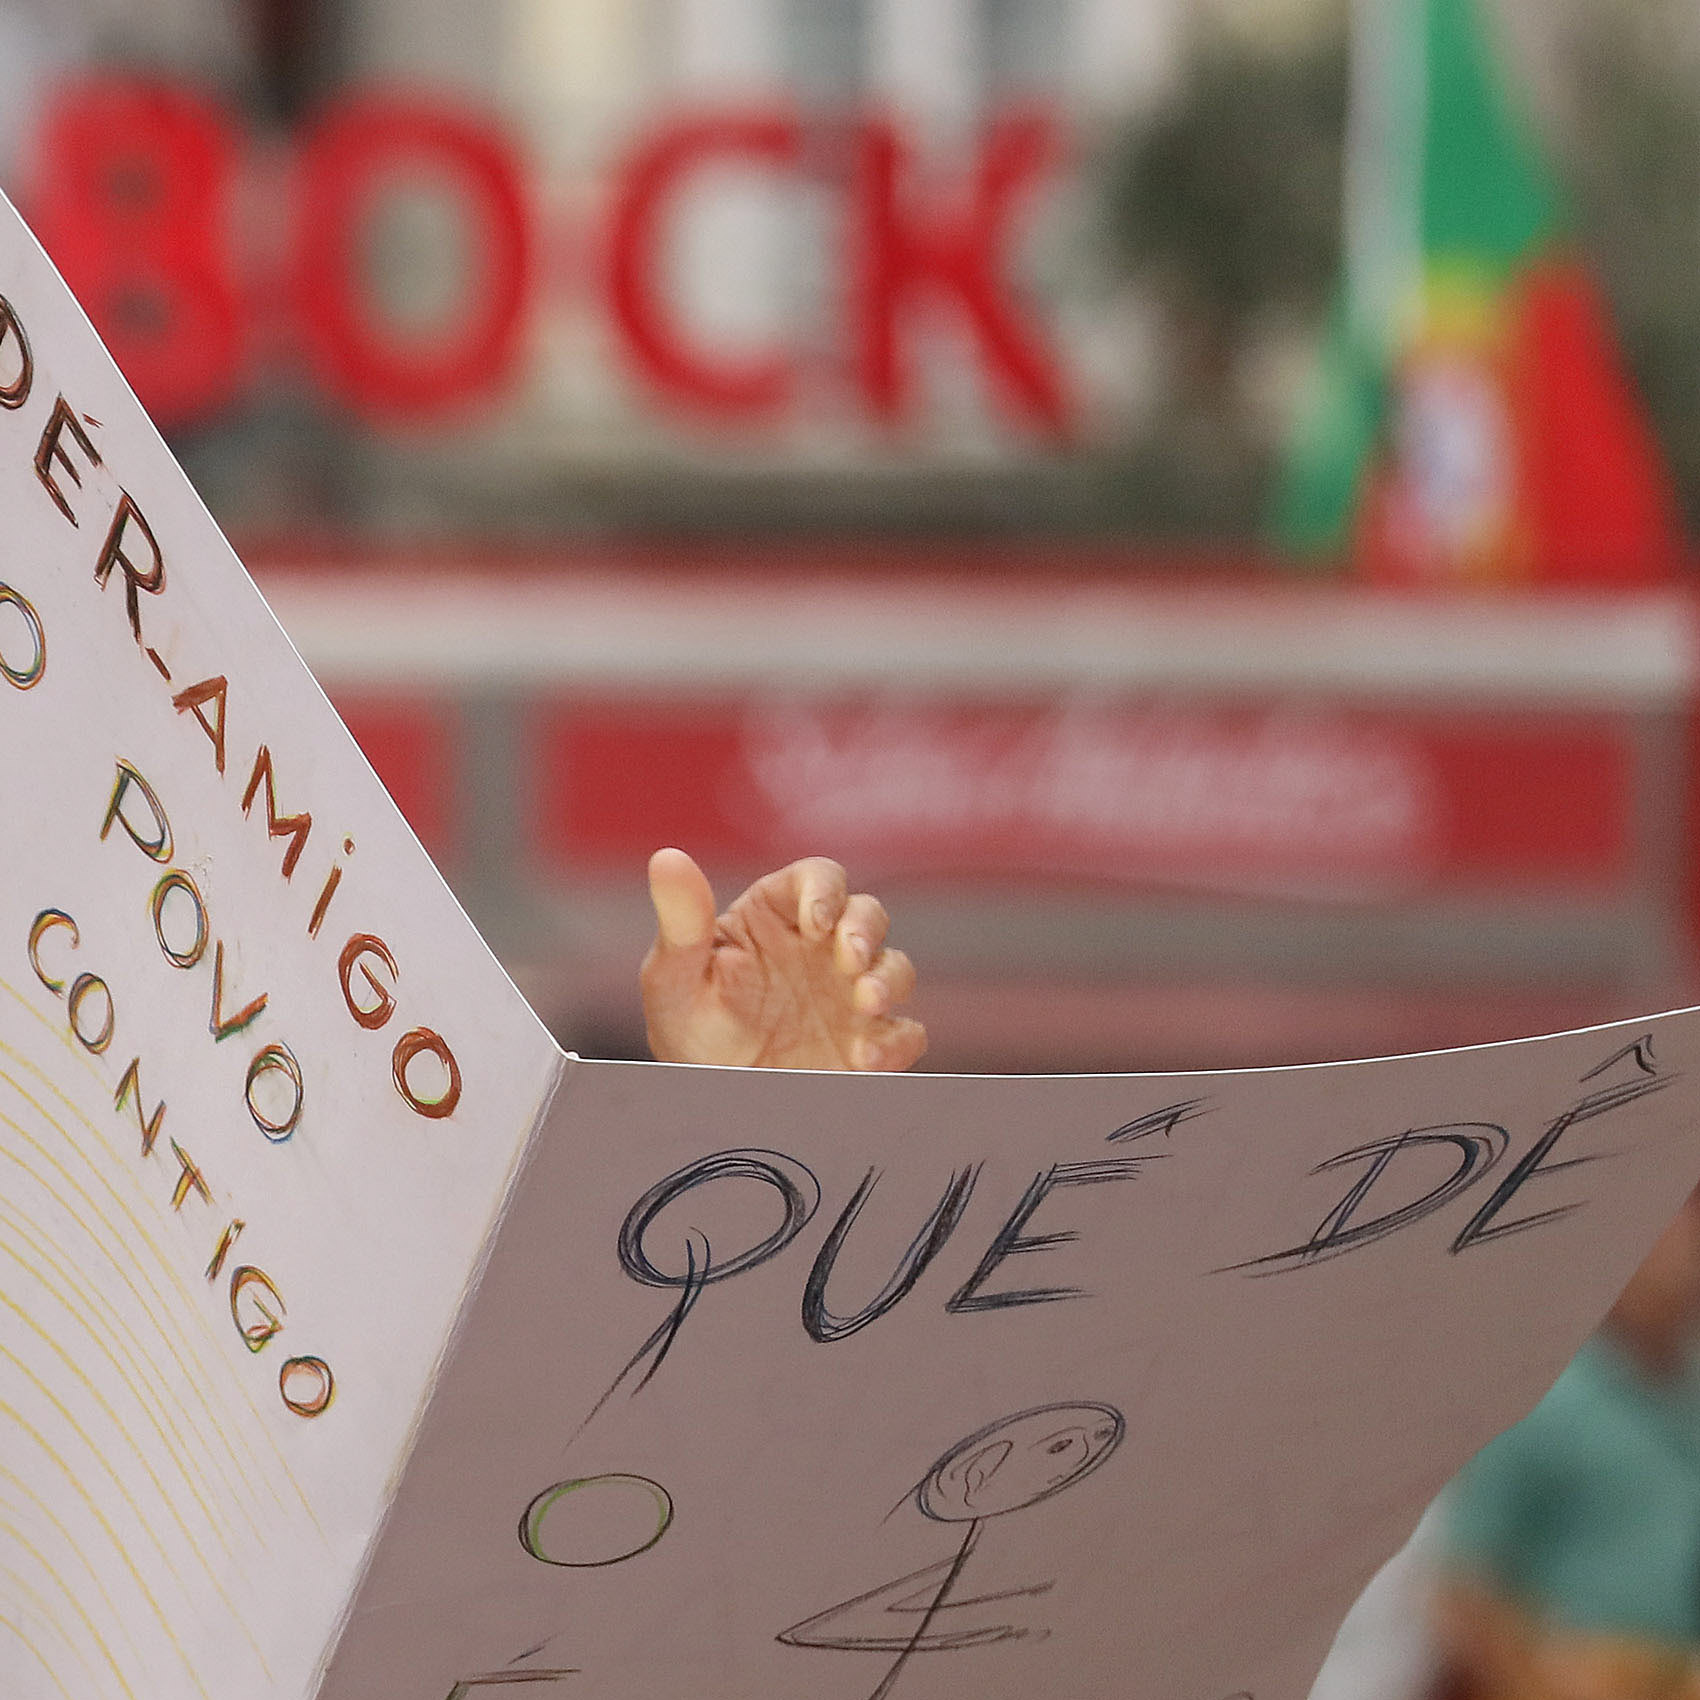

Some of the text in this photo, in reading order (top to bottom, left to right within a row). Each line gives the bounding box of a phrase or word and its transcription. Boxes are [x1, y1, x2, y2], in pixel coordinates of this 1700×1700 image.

[40, 85, 1072, 440] BOCK
[100, 757, 305, 1145] POVO
[518, 1473, 674, 1568] O
